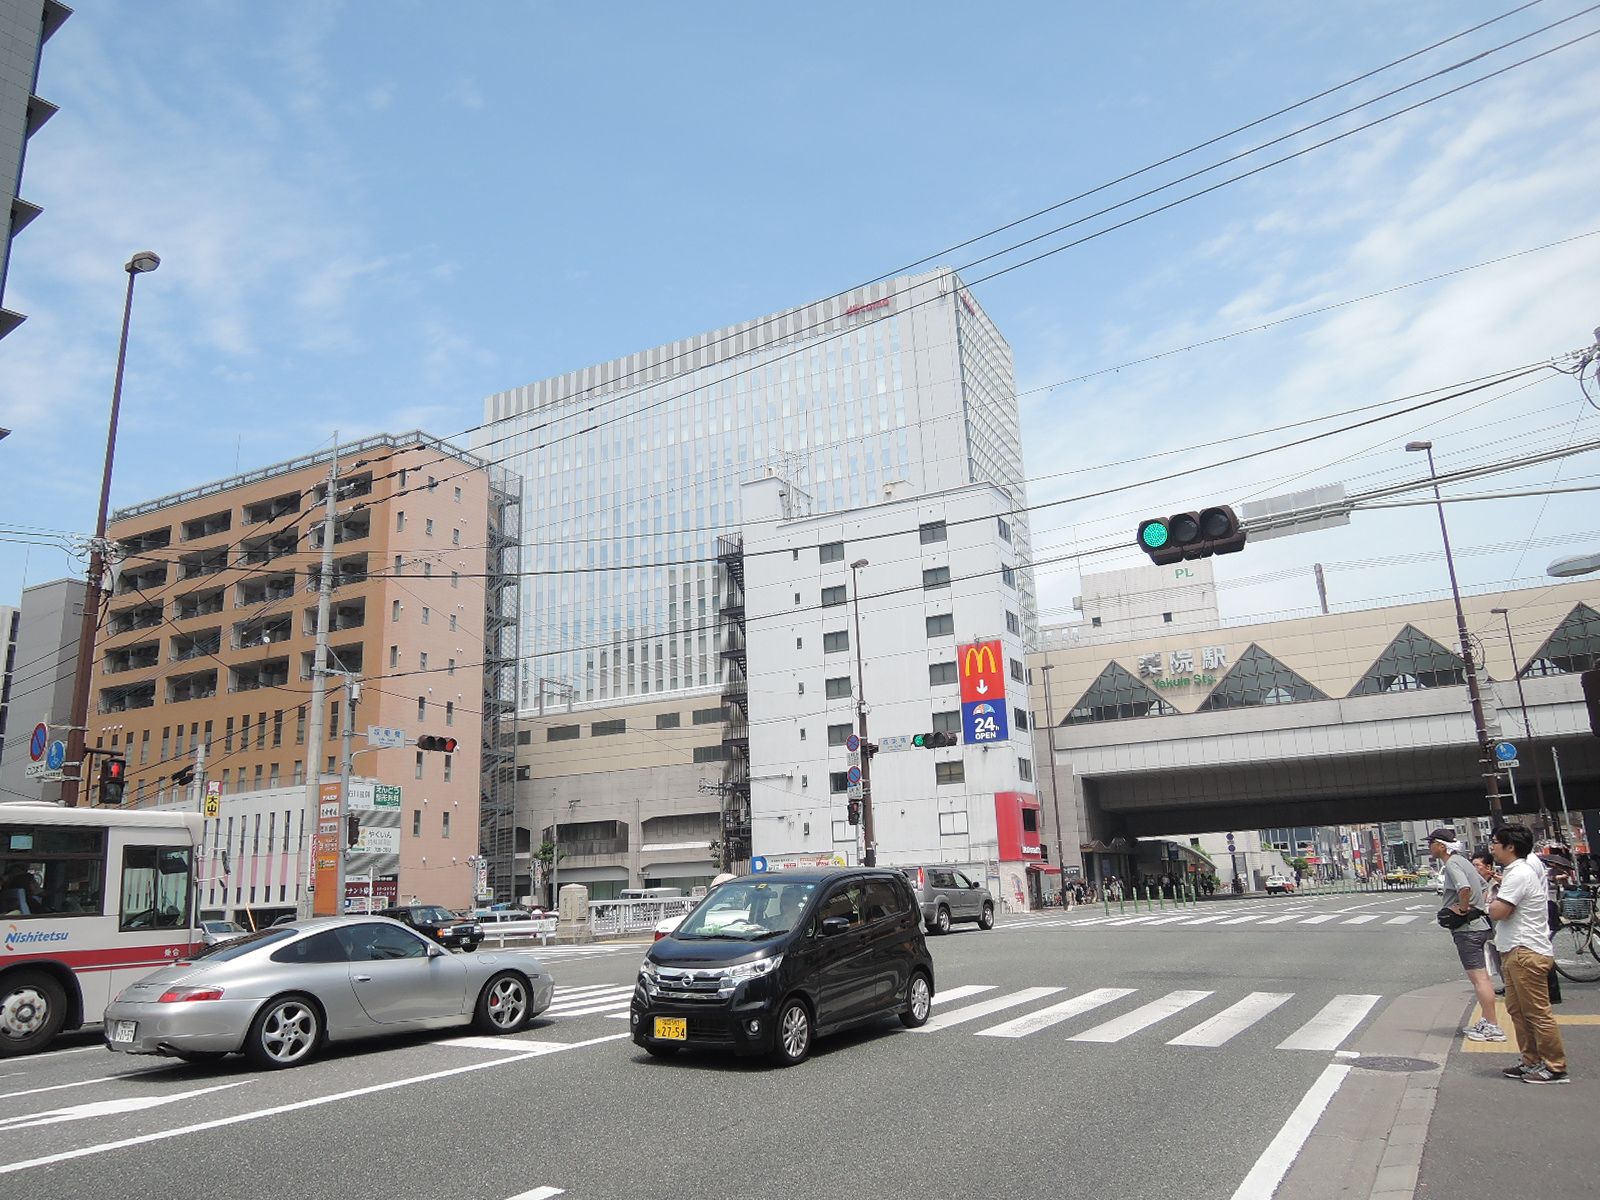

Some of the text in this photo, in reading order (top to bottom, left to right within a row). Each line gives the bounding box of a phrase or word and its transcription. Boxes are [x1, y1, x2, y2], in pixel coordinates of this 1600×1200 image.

[1174, 568, 1194, 579] PL
[1138, 646, 1227, 678] 薬院駅
[975, 731, 997, 740] OPEN
[5, 931, 69, 944] Nishitetsu
[661, 1026, 685, 1038] 27-54
